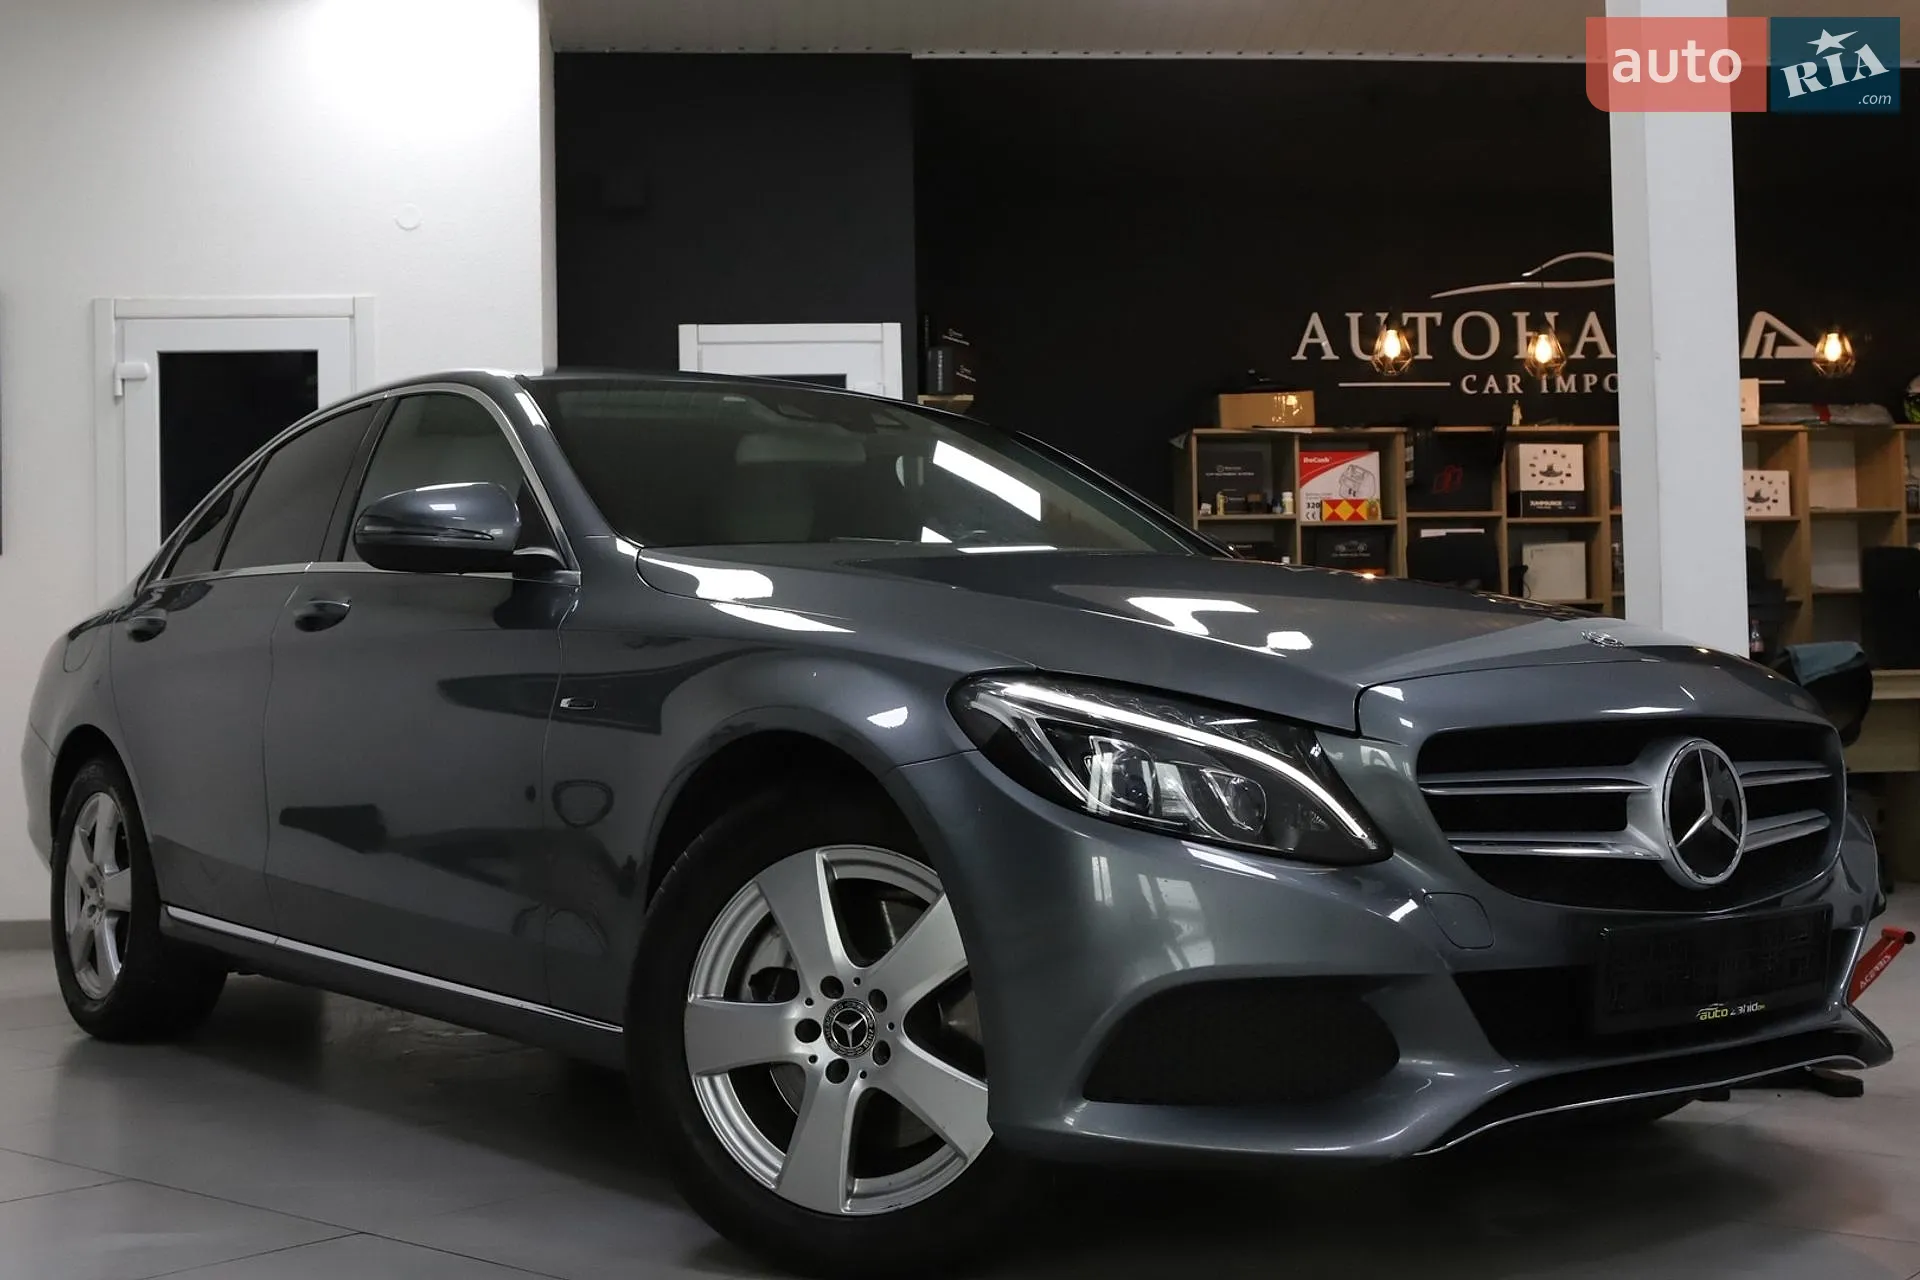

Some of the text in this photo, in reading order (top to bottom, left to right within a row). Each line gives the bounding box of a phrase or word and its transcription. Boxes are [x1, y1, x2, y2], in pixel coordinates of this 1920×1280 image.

[1291, 310, 1617, 361] AUTOHA
[1460, 373, 1619, 394] CAR IMPO
